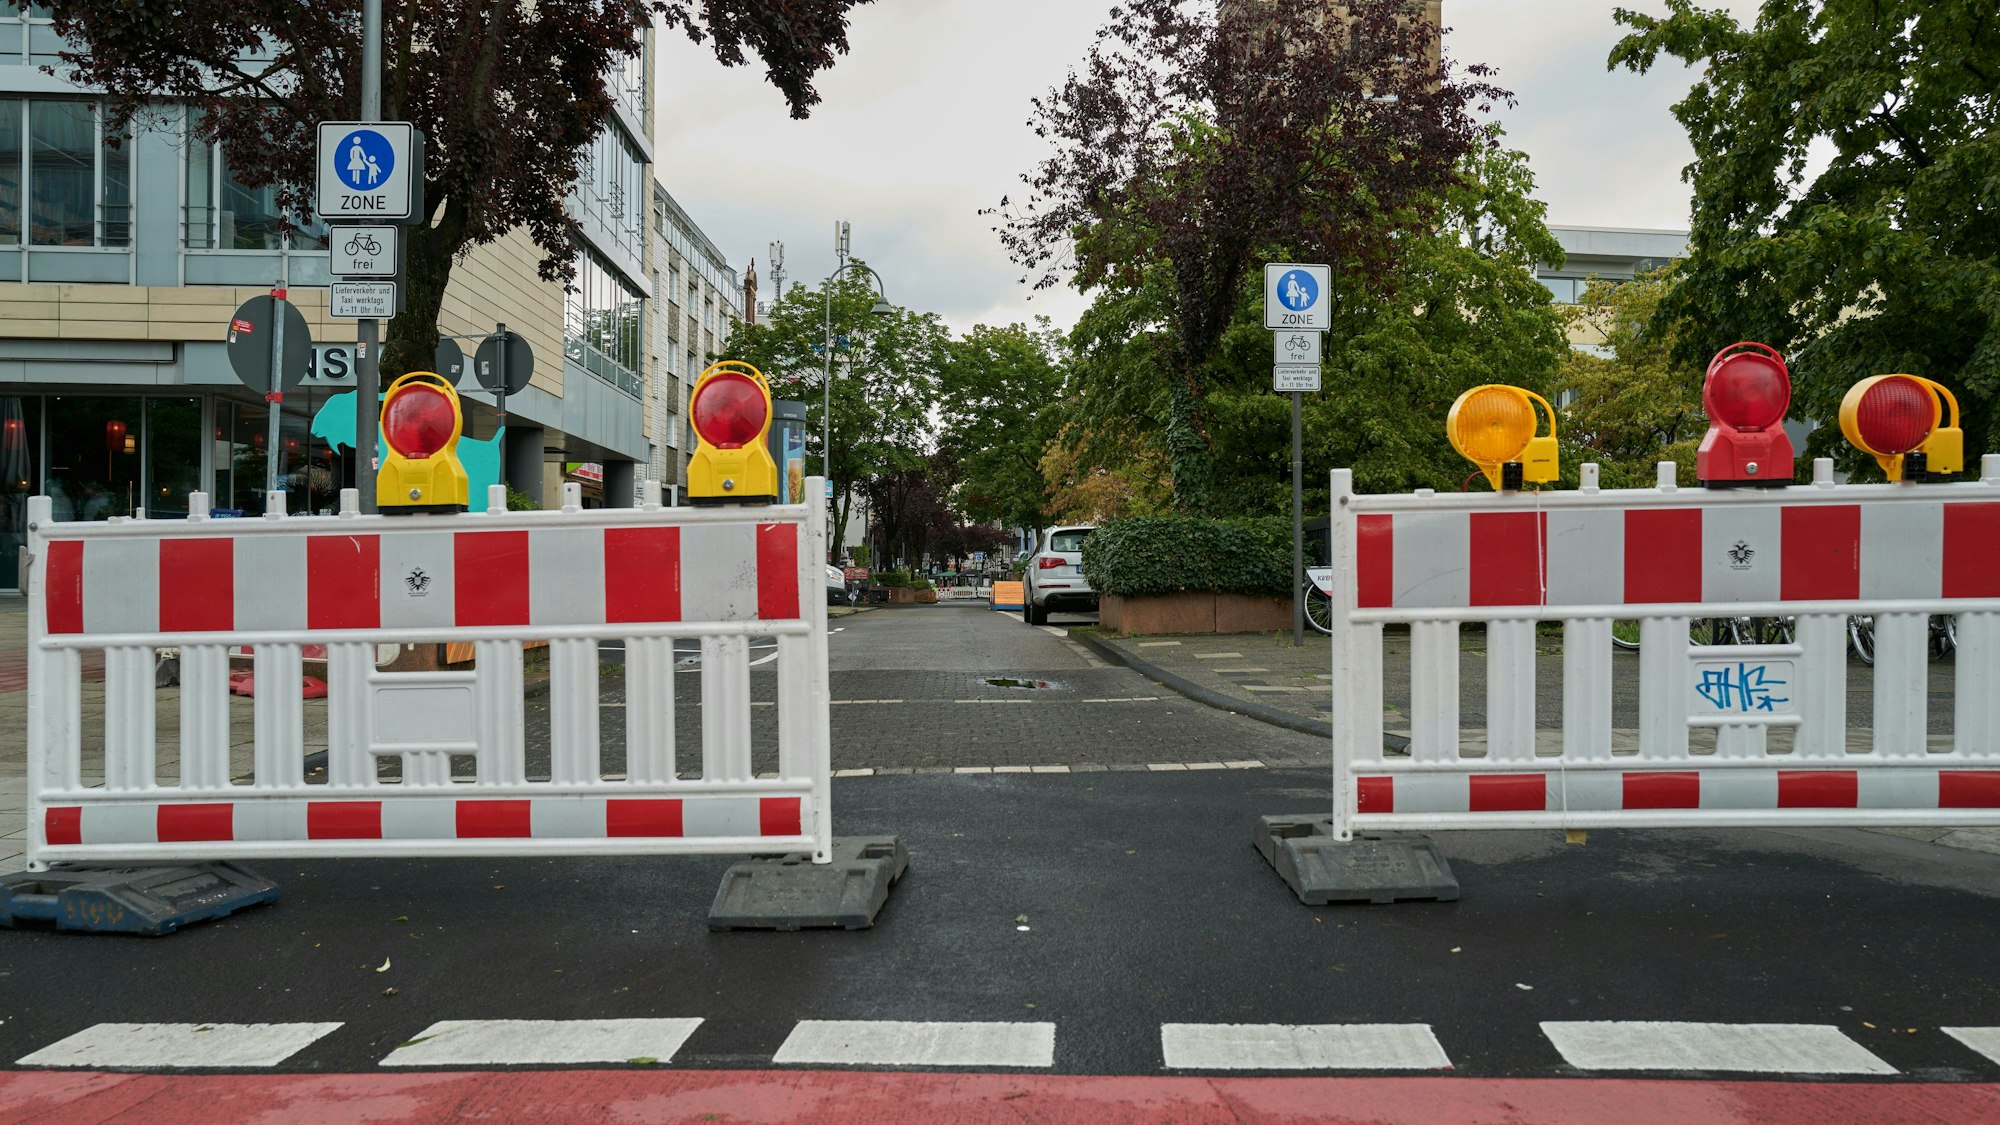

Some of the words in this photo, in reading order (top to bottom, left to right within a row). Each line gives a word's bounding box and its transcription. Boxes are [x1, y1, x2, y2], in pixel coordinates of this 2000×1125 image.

[341, 195, 386, 210] ZONE
[353, 259, 373, 269] frei
[335, 286, 376, 294] Lieferverkehr
[378, 286, 391, 294] und
[356, 296, 384, 305] werktags
[339, 306, 344, 314] 6
[351, 306, 357, 314] 11
[360, 306, 371, 314] Uhr
[374, 306, 385, 314] frei
[1282, 314, 1314, 324] ZONE
